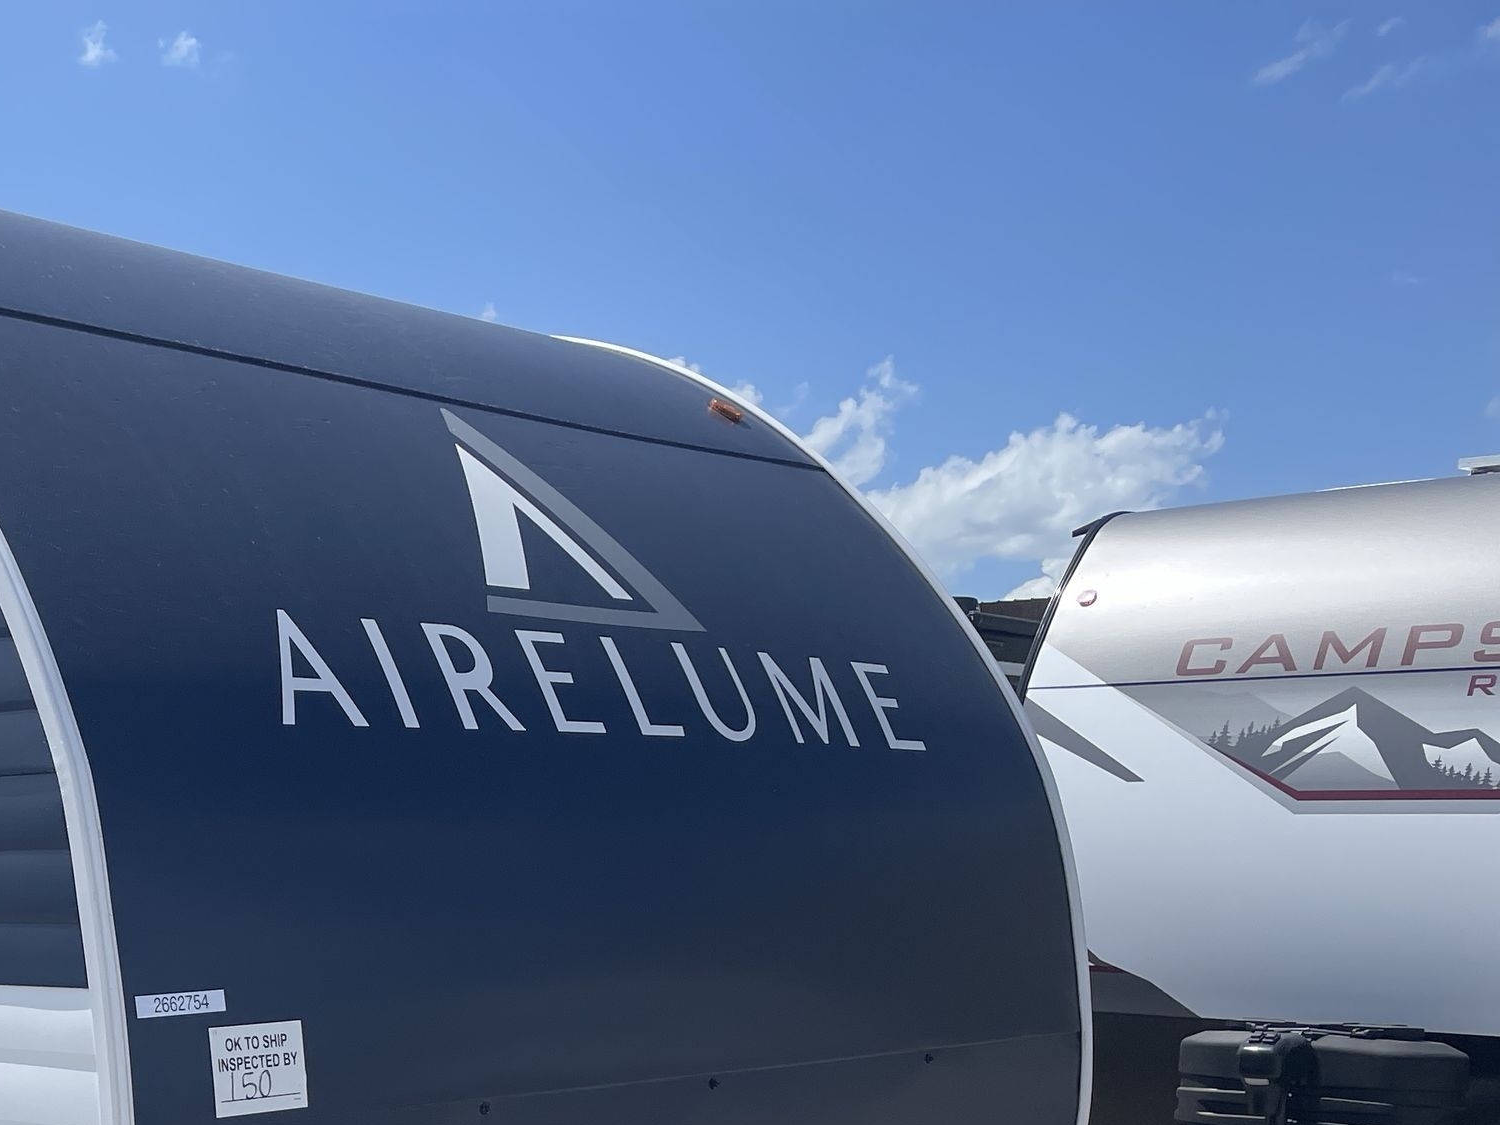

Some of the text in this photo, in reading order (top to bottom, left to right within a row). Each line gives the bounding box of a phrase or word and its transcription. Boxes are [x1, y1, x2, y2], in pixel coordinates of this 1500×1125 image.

[276, 608, 927, 752] AIRELUME
[153, 993, 210, 1014] 2662754
[224, 1033, 288, 1052] OK TO SHIP
[217, 1051, 298, 1073] INSPECTED BY
